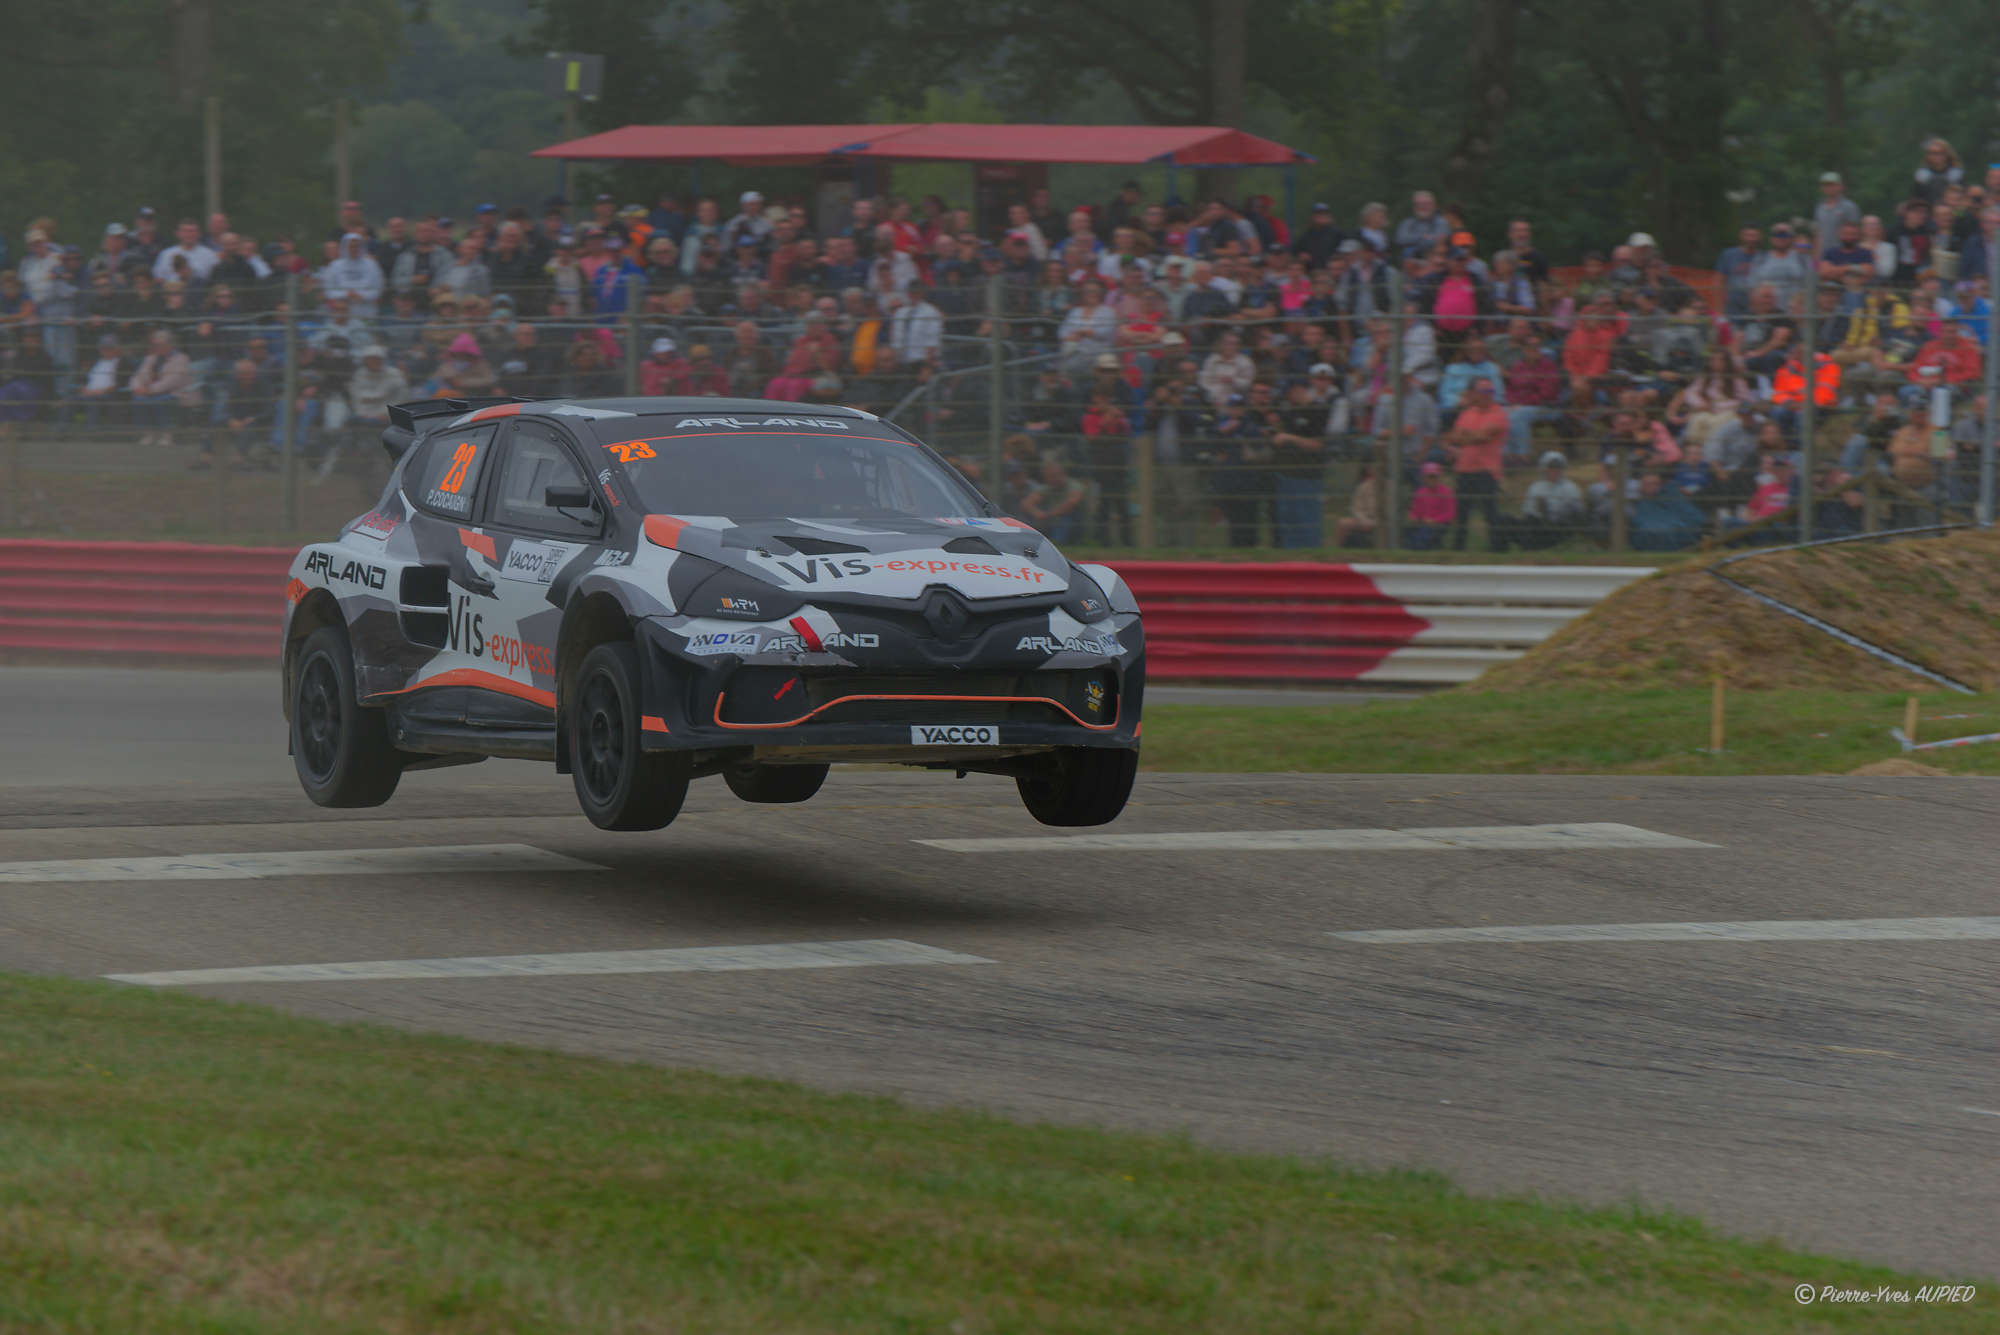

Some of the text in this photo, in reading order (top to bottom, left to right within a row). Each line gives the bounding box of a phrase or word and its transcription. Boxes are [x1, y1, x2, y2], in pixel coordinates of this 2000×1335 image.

[675, 417, 848, 429] ARLAND
[608, 442, 657, 463] 23
[440, 443, 477, 494] 23
[304, 550, 387, 590] ARLAND
[508, 549, 543, 573] YACCO
[777, 557, 1045, 584] Vis-express.fr
[1016, 636, 1102, 655] ARLAND
[919, 727, 991, 743] YACCO
